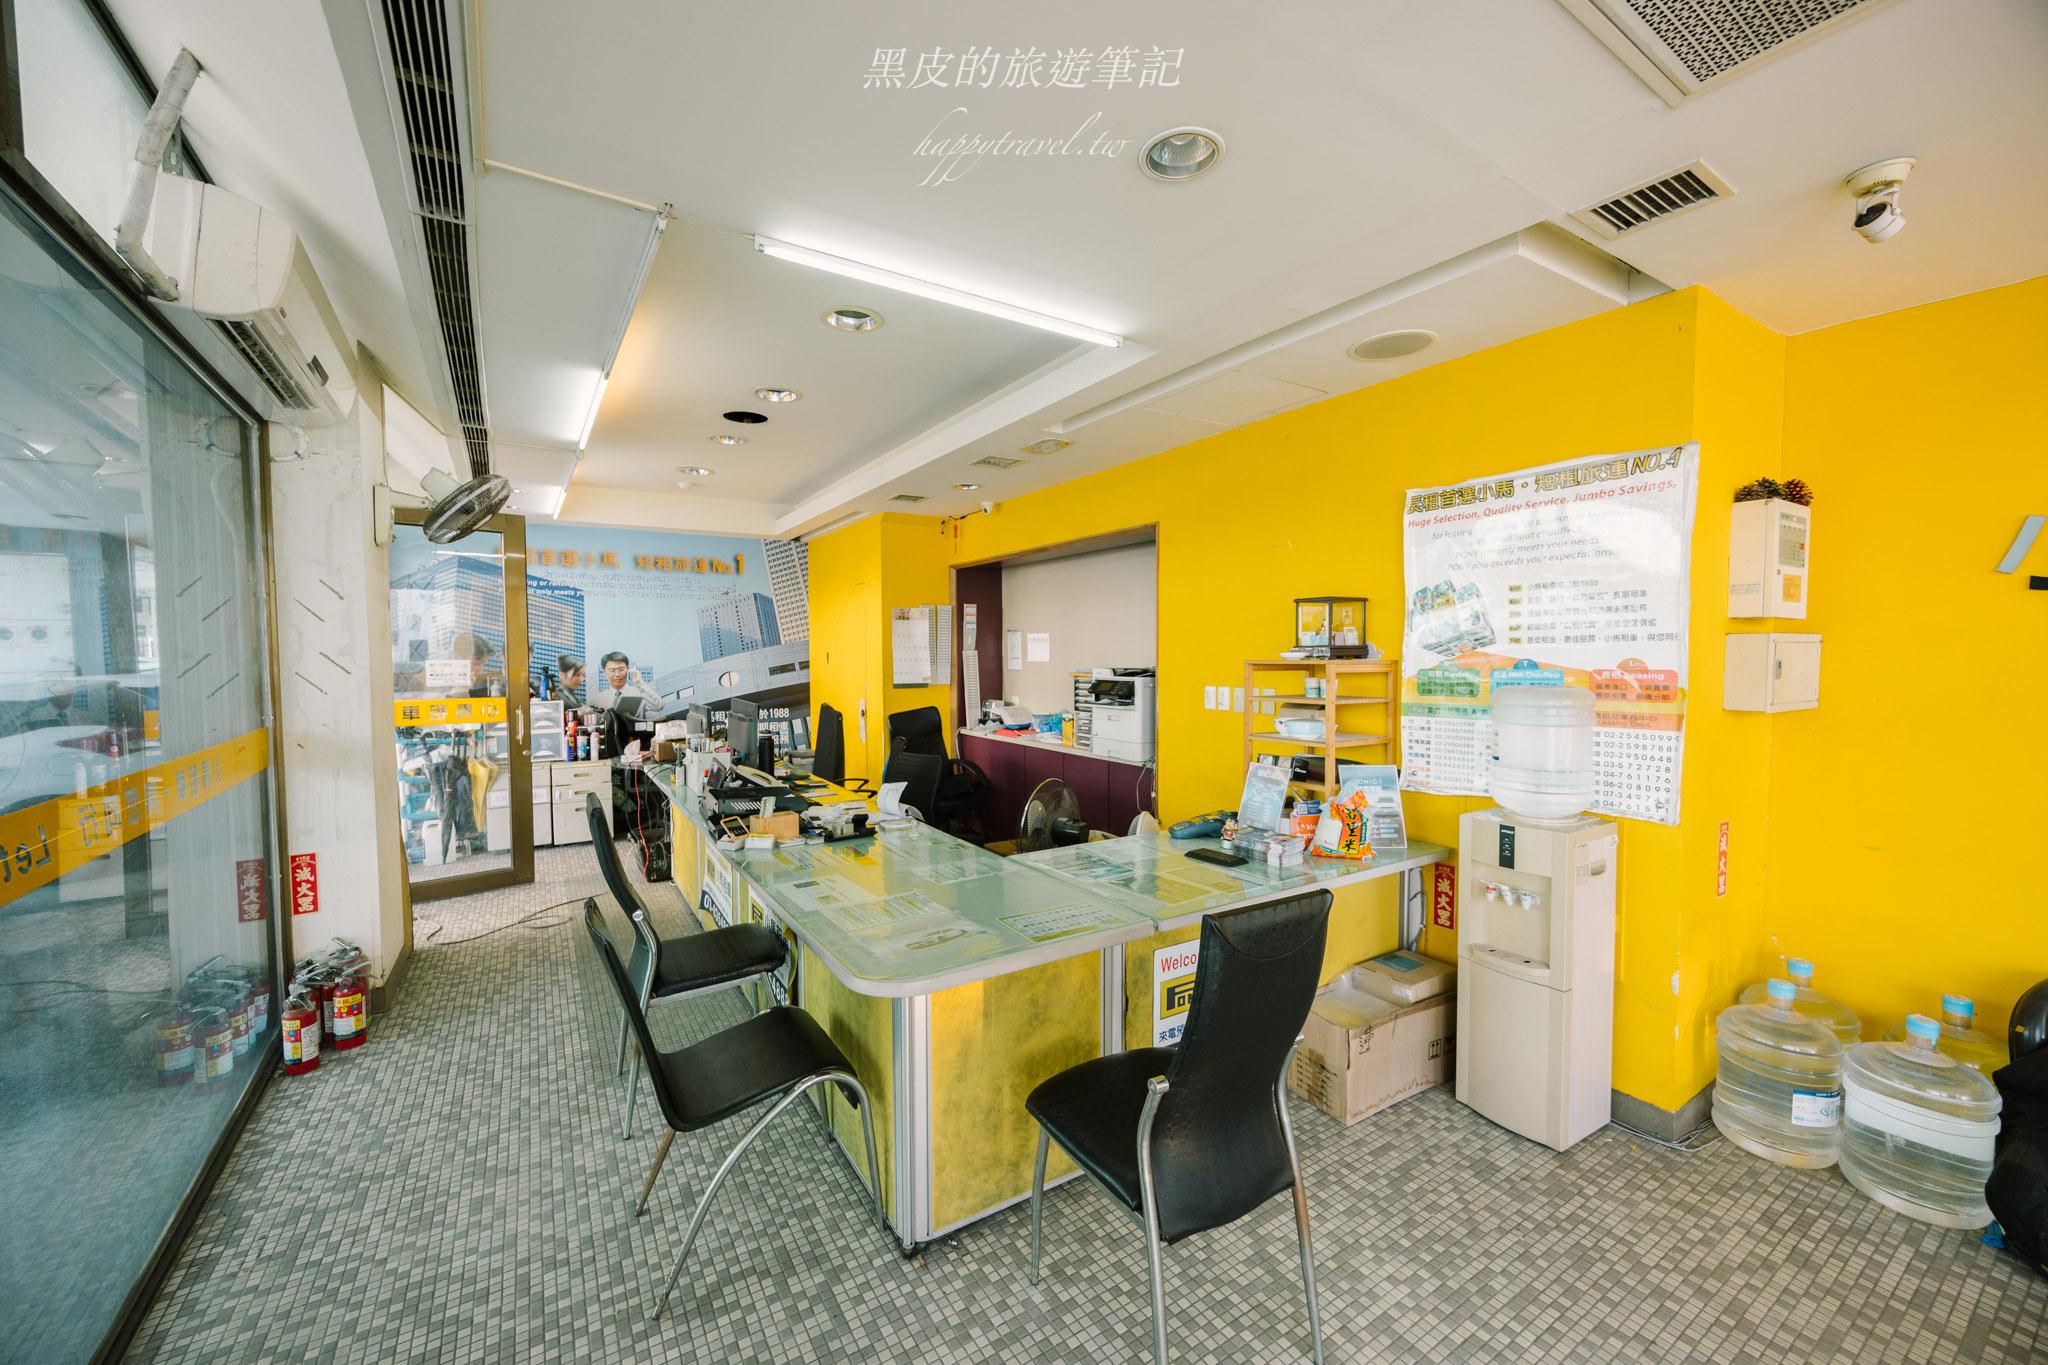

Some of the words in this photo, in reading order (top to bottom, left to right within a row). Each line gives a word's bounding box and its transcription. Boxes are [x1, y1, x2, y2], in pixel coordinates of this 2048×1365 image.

[1408, 519, 1431, 529] Huge
[1573, 488, 1615, 503] Jumbo
[1618, 479, 1677, 496] Savings,
[294, 866, 316, 913] 滅火器
[1436, 878, 1453, 927] 滅火器
[1160, 953, 1197, 974] Welco
